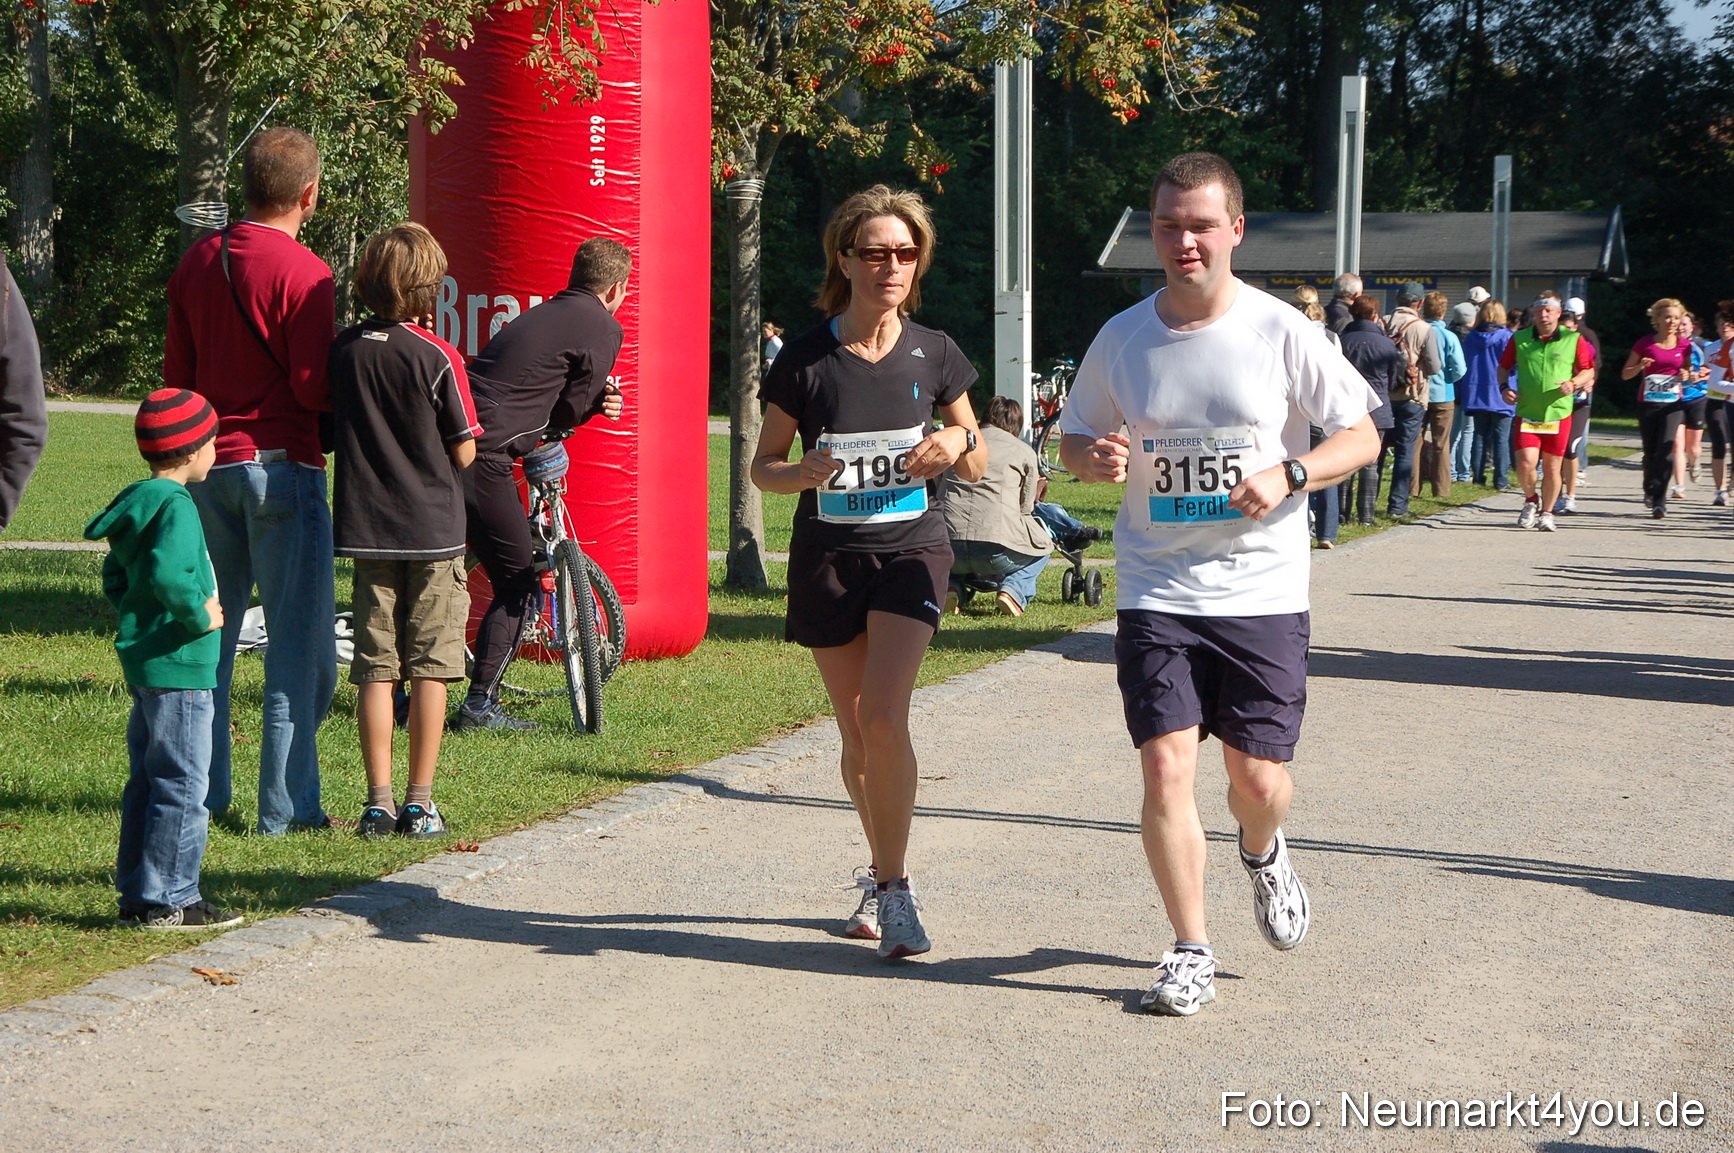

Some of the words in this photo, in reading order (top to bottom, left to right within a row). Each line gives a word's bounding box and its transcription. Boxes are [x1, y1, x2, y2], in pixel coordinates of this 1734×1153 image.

[589, 115, 606, 152] 1929
[589, 158, 606, 187] Seit
[435, 275, 556, 357] Bra
[829, 439, 877, 450] PFLEIDERER
[1155, 437, 1203, 448] PFLEIDERER
[828, 453, 912, 491] 2199
[1154, 454, 1243, 494] 3155
[847, 490, 897, 514] Birgit
[1174, 496, 1224, 517] Ferdl
